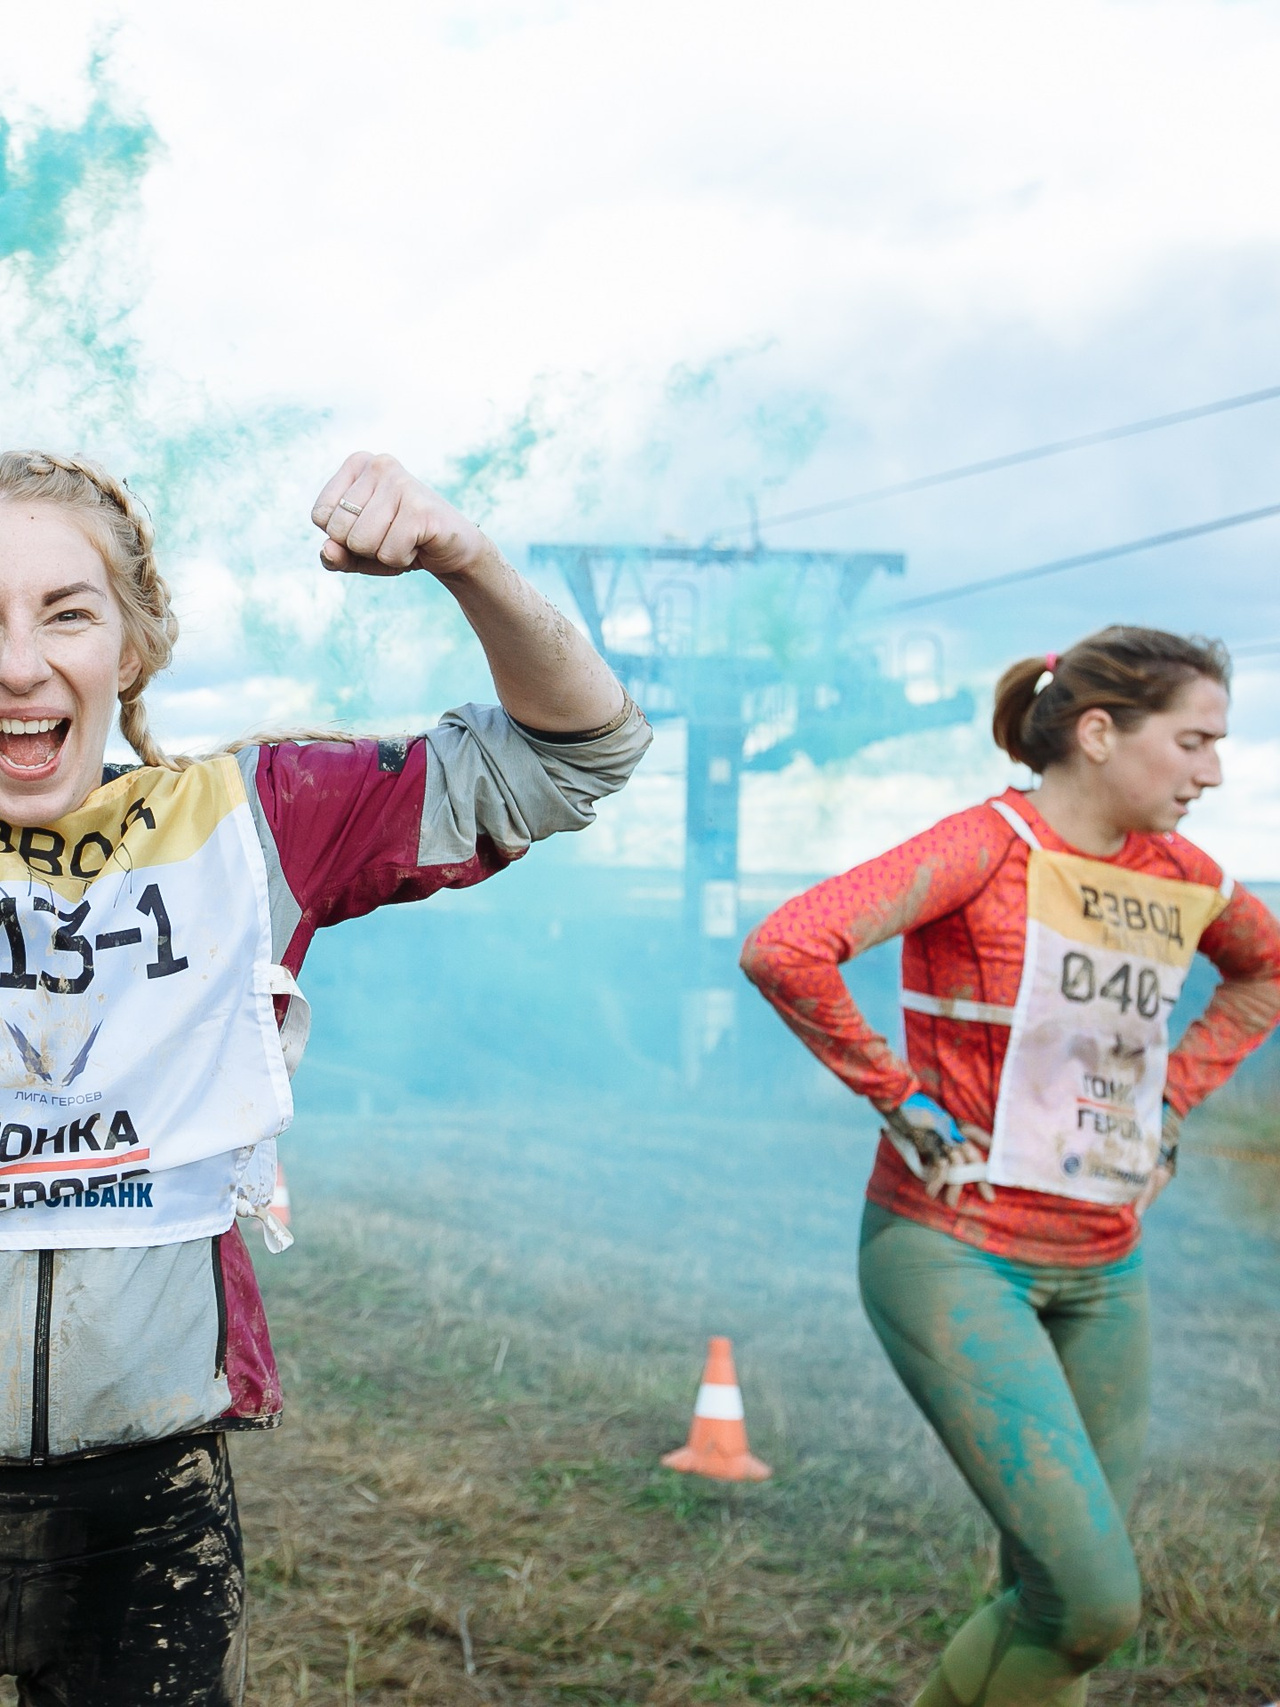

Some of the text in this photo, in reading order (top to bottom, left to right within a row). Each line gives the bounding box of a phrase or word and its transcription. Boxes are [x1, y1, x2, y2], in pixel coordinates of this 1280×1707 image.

[1080, 884, 1184, 947] ВЗВОД
[14, 1091, 102, 1107] ЛИГА ГЕРОЕВ
